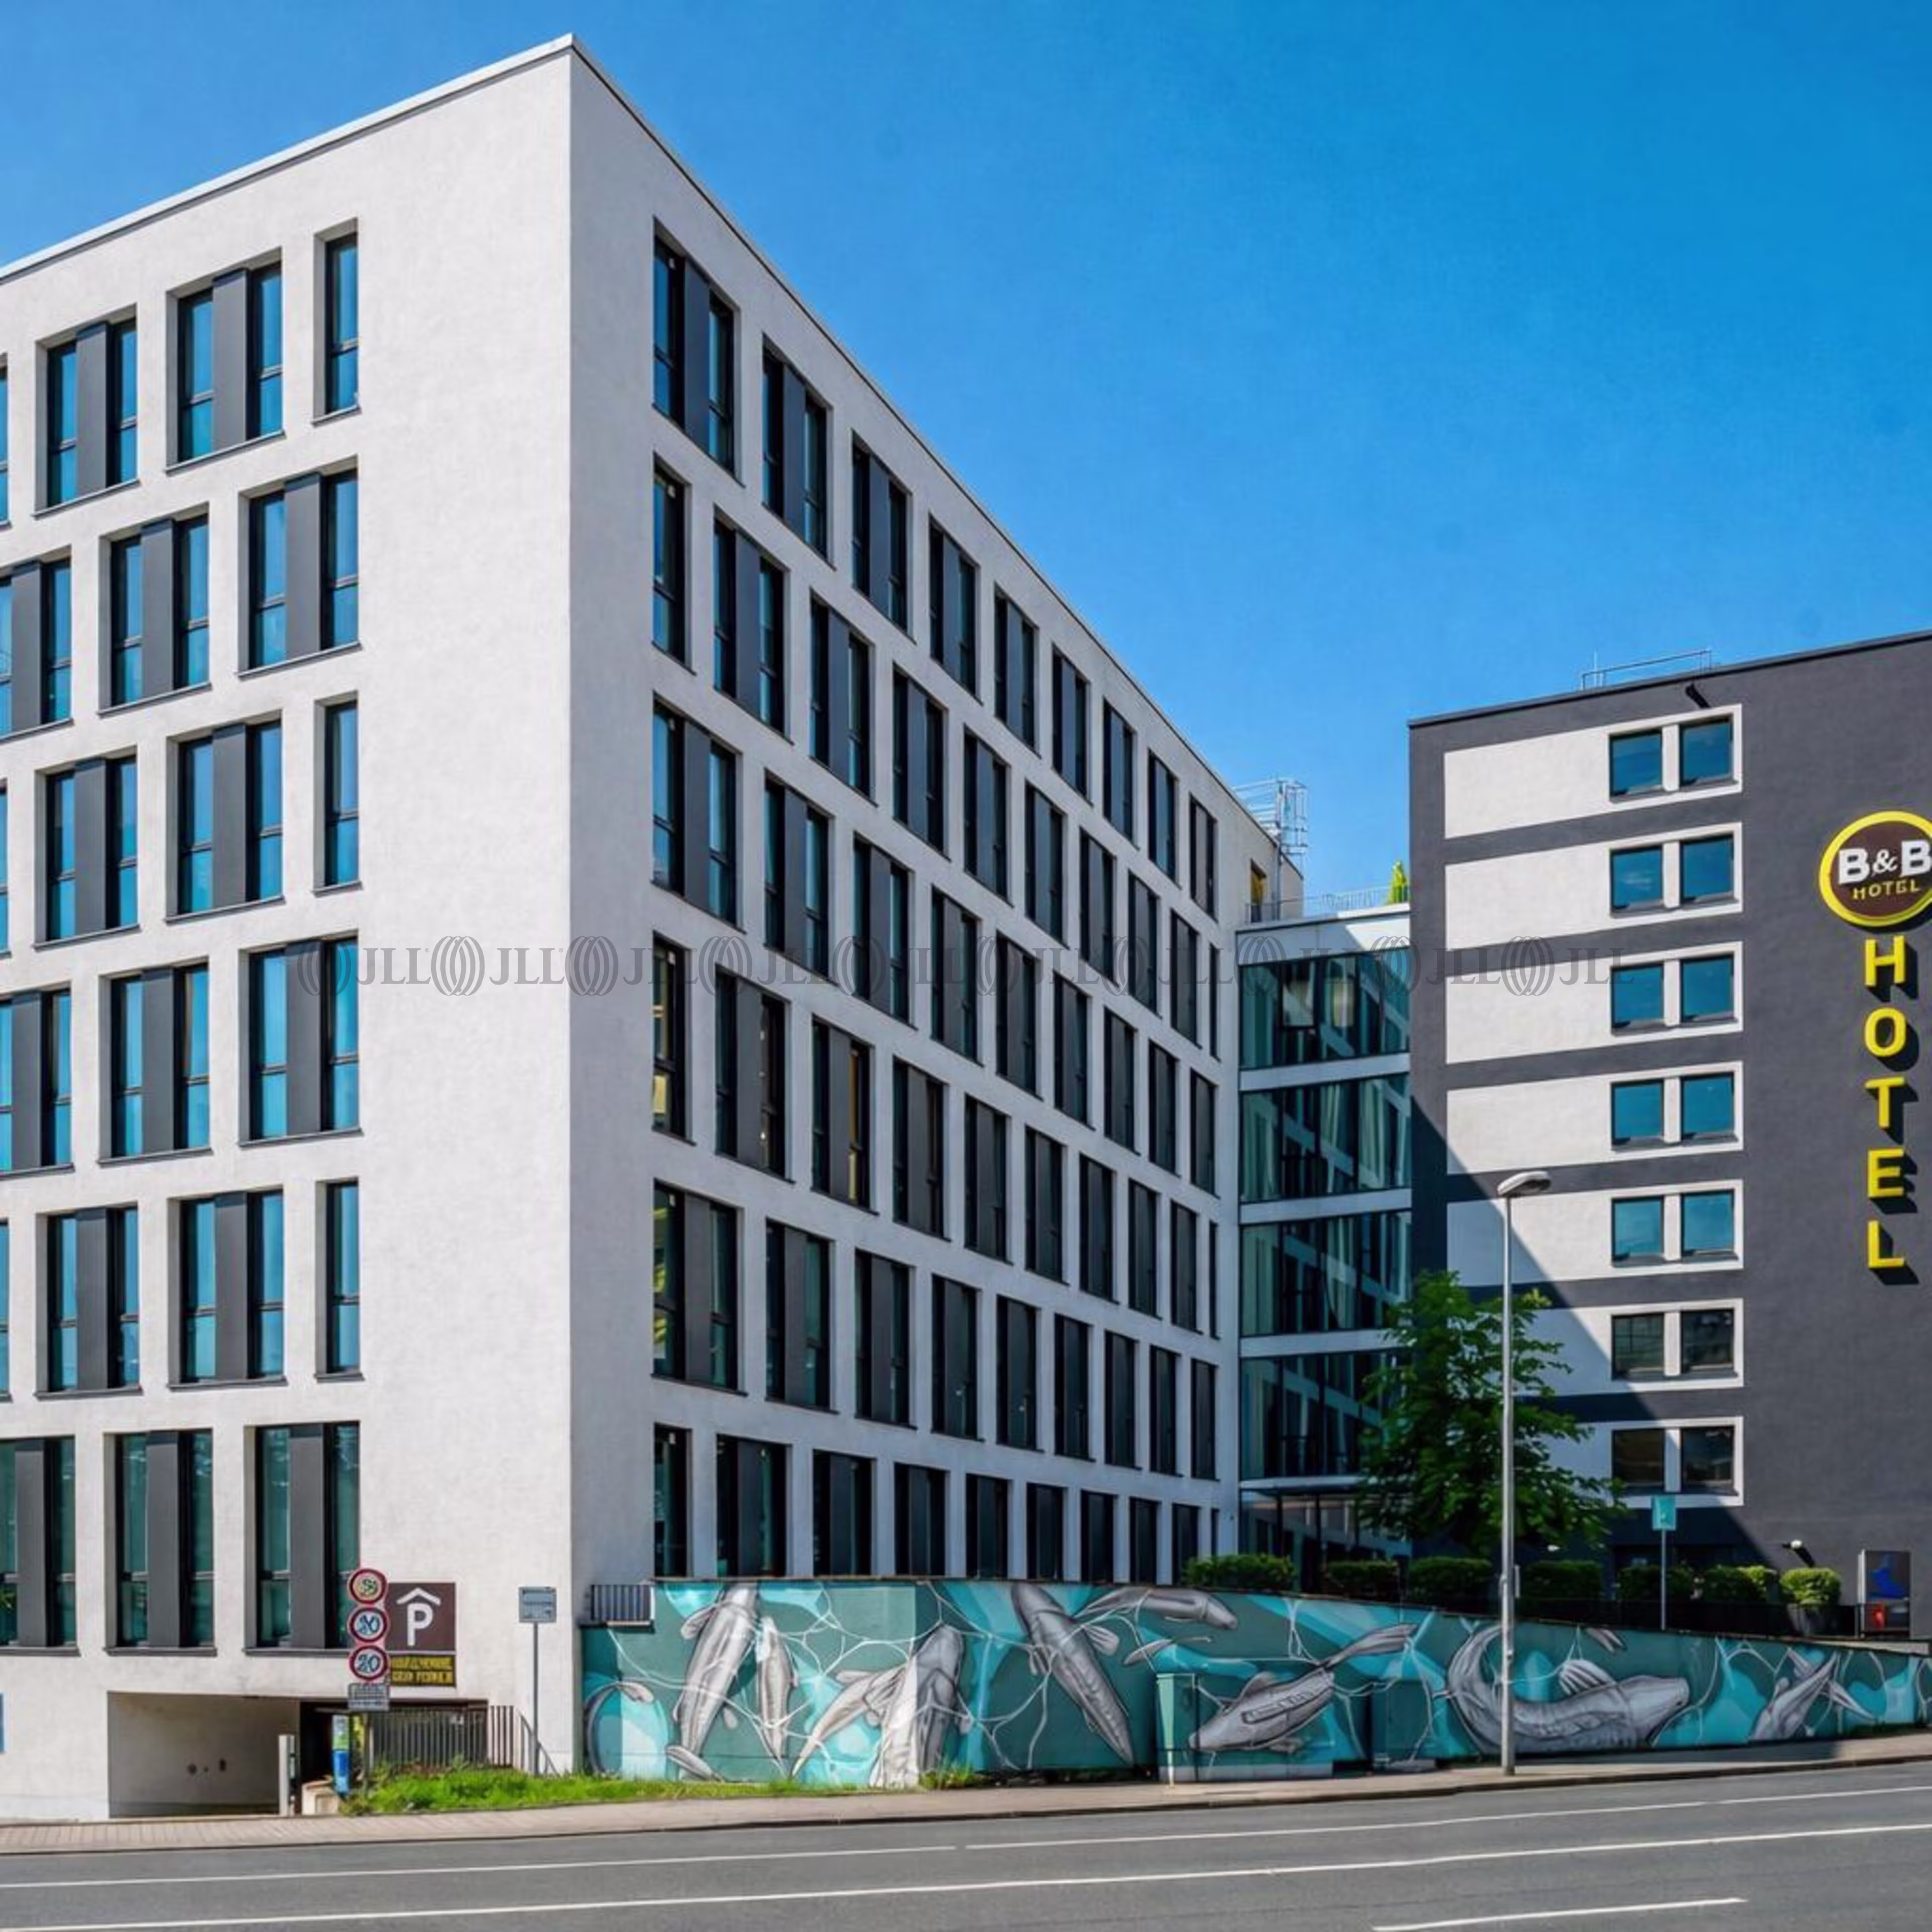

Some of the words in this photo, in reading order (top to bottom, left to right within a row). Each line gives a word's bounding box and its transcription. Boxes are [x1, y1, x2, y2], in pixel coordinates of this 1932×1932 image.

[1838, 839, 1932, 884] B&B
[1853, 879, 1921, 901] HOTEL
[1864, 935, 1906, 1269] HOTEL
[407, 1602, 434, 1647] P
